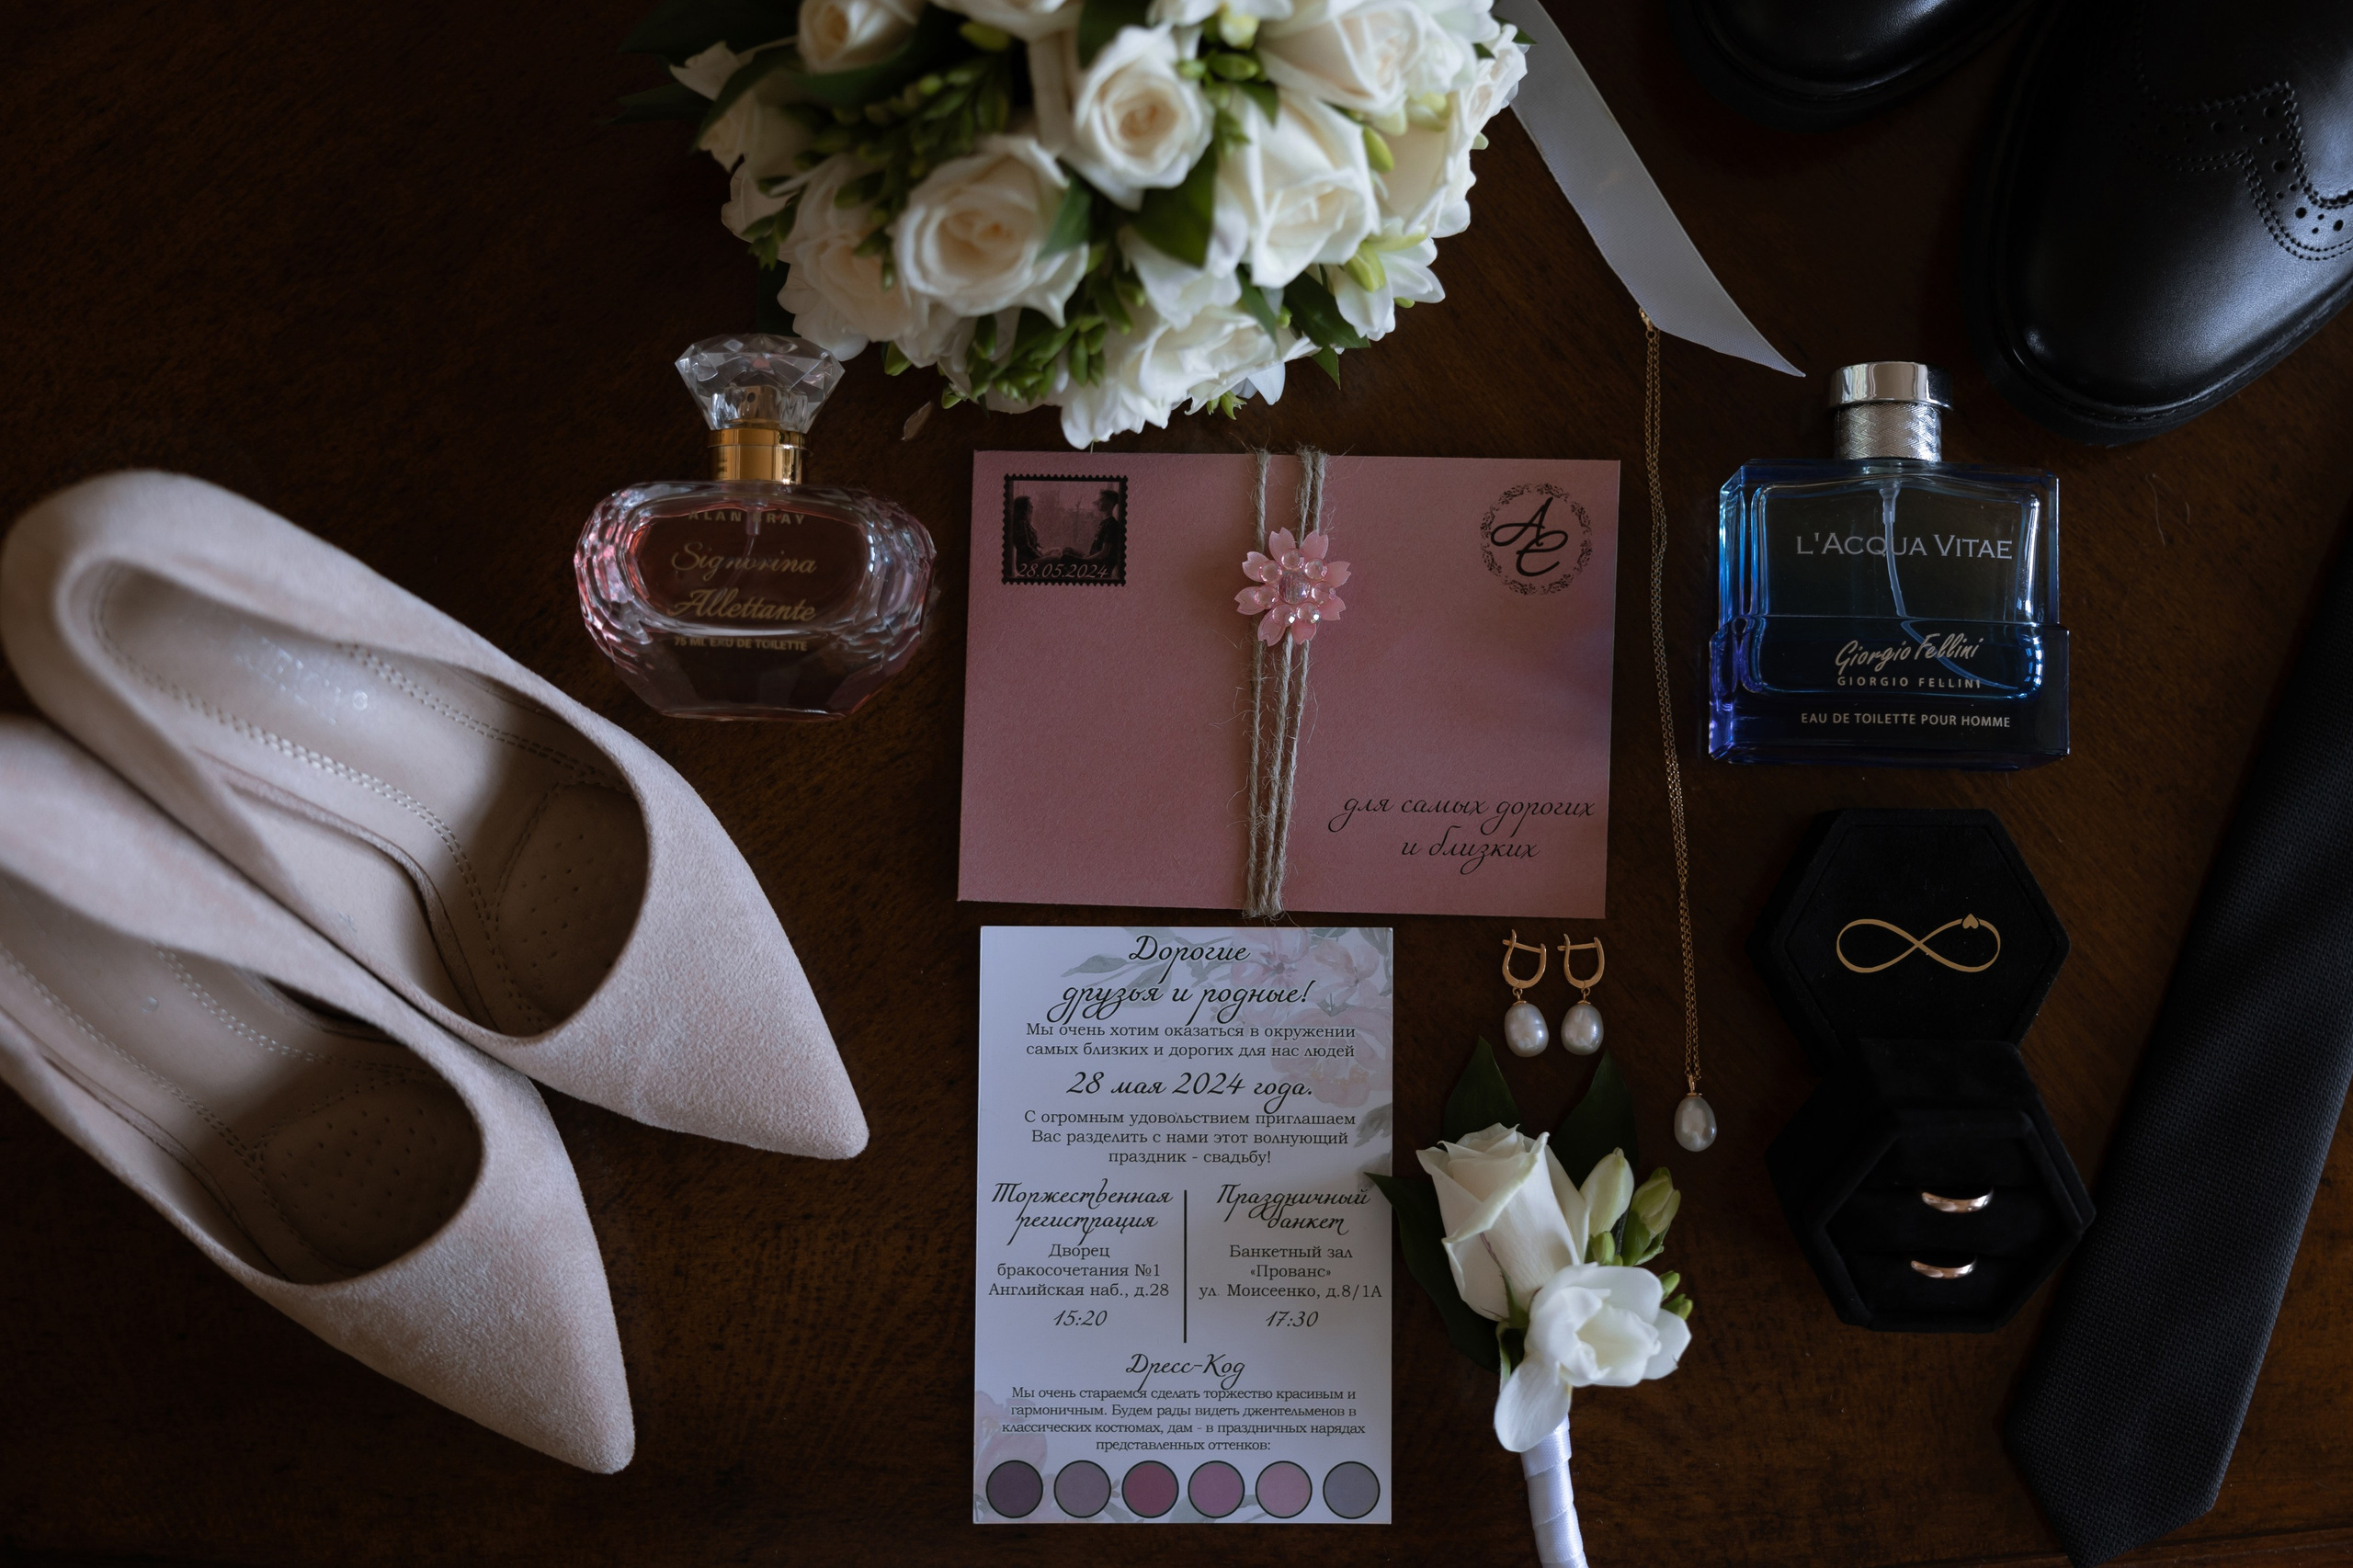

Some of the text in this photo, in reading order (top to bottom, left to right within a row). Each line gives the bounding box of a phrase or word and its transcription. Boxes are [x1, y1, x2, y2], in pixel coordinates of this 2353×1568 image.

[689, 511, 743, 522] ALAN
[1934, 534, 2013, 560] VITAE
[671, 541, 817, 582] Signorina
[1017, 563, 1108, 578] 28.05.2024
[667, 587, 816, 621] Allettante
[710, 638, 733, 648] EAU
[737, 639, 752, 649] DE
[756, 640, 808, 652] TOILETTE
[1835, 632, 1984, 676] Giorgio Fellini
[1837, 676, 1981, 689] GIORGIO FELLINI
[1801, 712, 2010, 728] EAU DE TOILETTE POUR HOMME
[1328, 799, 1595, 837] для самых дорогих
[1402, 825, 1540, 875] и близких
[1129, 936, 1250, 984] Дорогие
[1046, 980, 1316, 1026] друзья и родные!
[1026, 1023, 1054, 1035] Мы
[1059, 1027, 1106, 1035] очень
[1109, 1027, 1160, 1036] хотим
[1164, 1025, 1245, 1036] оказаться
[1264, 1028, 1356, 1040] окружении
[1026, 1042, 1355, 1059] самых близких и дорогих для нас людей
[1066, 1071, 1313, 1114] 28 мая 2024 года.
[1024, 1110, 1356, 1127] С огромным удовольствием приглашаем
[1031, 1130, 1348, 1147] Вас разделить с нами этот волнующий
[1108, 1153, 1188, 1165] праздник
[1203, 1151, 1271, 1166] свадьбу!
[992, 1178, 1174, 1221] Торжественная
[1217, 1184, 1370, 1222] Праздничный
[1267, 1204, 1349, 1235] банкет
[1006, 1216, 1158, 1245] регистрация
[1047, 1243, 1110, 1260] Дворец
[1229, 1245, 1354, 1257] Банкетный зал
[997, 1263, 1160, 1278] бракосочетания №1
[1250, 1265, 1332, 1280] «Прованс»
[988, 1283, 1169, 1298] Английская наб., д.28
[1227, 1284, 1321, 1299] Моисеенко,
[1053, 1310, 1108, 1326] 15:20
[1266, 1311, 1319, 1326] 17:30
[1126, 1354, 1245, 1392] Дресс-Код
[1011, 1387, 1035, 1397] Мы
[1038, 1390, 1076, 1398] очень
[1079, 1389, 1148, 1401] стараемся
[1150, 1391, 1201, 1400] сделать
[1202, 1389, 1273, 1401] торжество
[1276, 1391, 1344, 1402] красивым
[1011, 1407, 1108, 1417] гармоничным.
[1111, 1404, 1153, 1418] Будем
[1156, 1408, 1191, 1418] рады
[1195, 1408, 1240, 1417] видеть
[1242, 1408, 1346, 1417] джентельменов
[1095, 1425, 1164, 1434] костюмах,
[1166, 1425, 1193, 1434] дам
[1217, 1426, 1307, 1436] праздничных
[1310, 1426, 1366, 1436] нарядах
[1096, 1442, 1205, 1452] представленных
